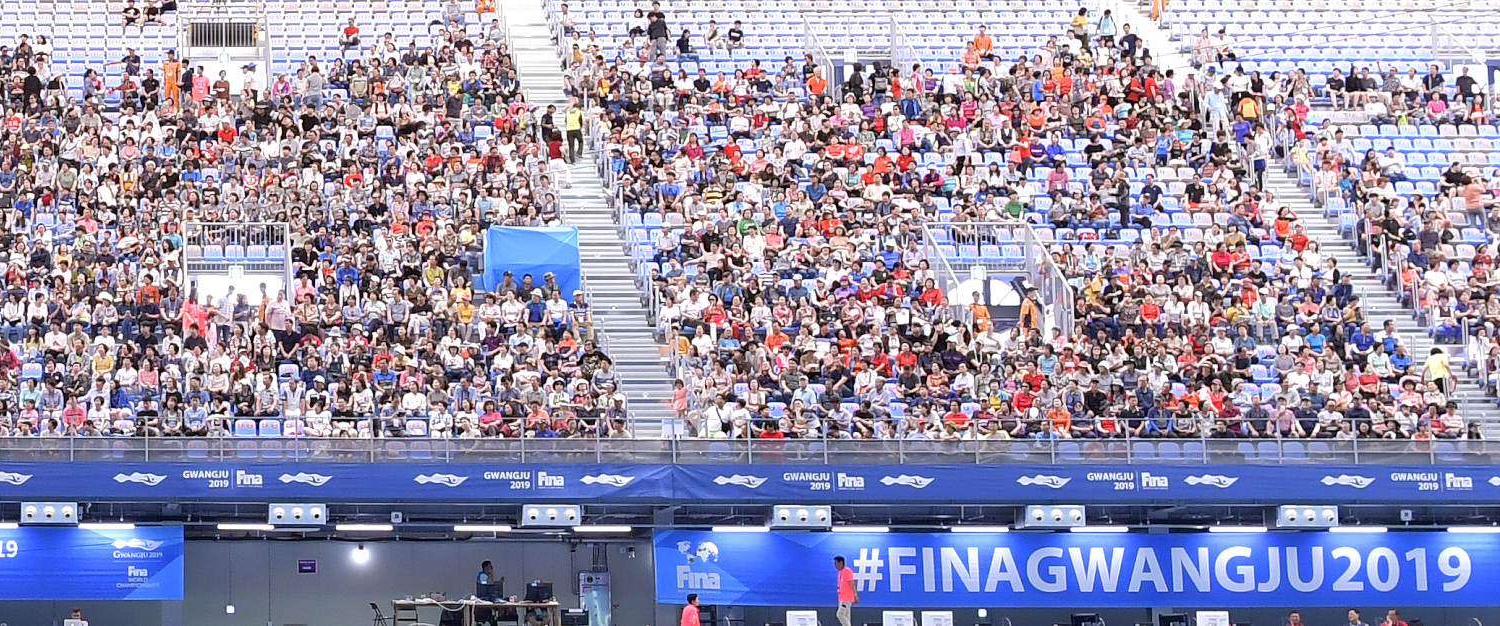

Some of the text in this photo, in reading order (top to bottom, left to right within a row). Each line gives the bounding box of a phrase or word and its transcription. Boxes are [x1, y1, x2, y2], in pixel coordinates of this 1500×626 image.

[182, 469, 229, 479] GWANGJU
[483, 471, 531, 480] GWANGJU
[783, 472, 830, 481] GWANGJU
[1086, 472, 1134, 481] GWANGJU
[1390, 472, 1438, 481] GWANGJU
[208, 479, 229, 488] 2019
[510, 481, 531, 490] 2019
[809, 481, 830, 490] 2019
[1113, 482, 1134, 491] 2019
[1418, 483, 1439, 491] 2019
[853, 546, 1471, 593] #FINAGWANGJU2019
